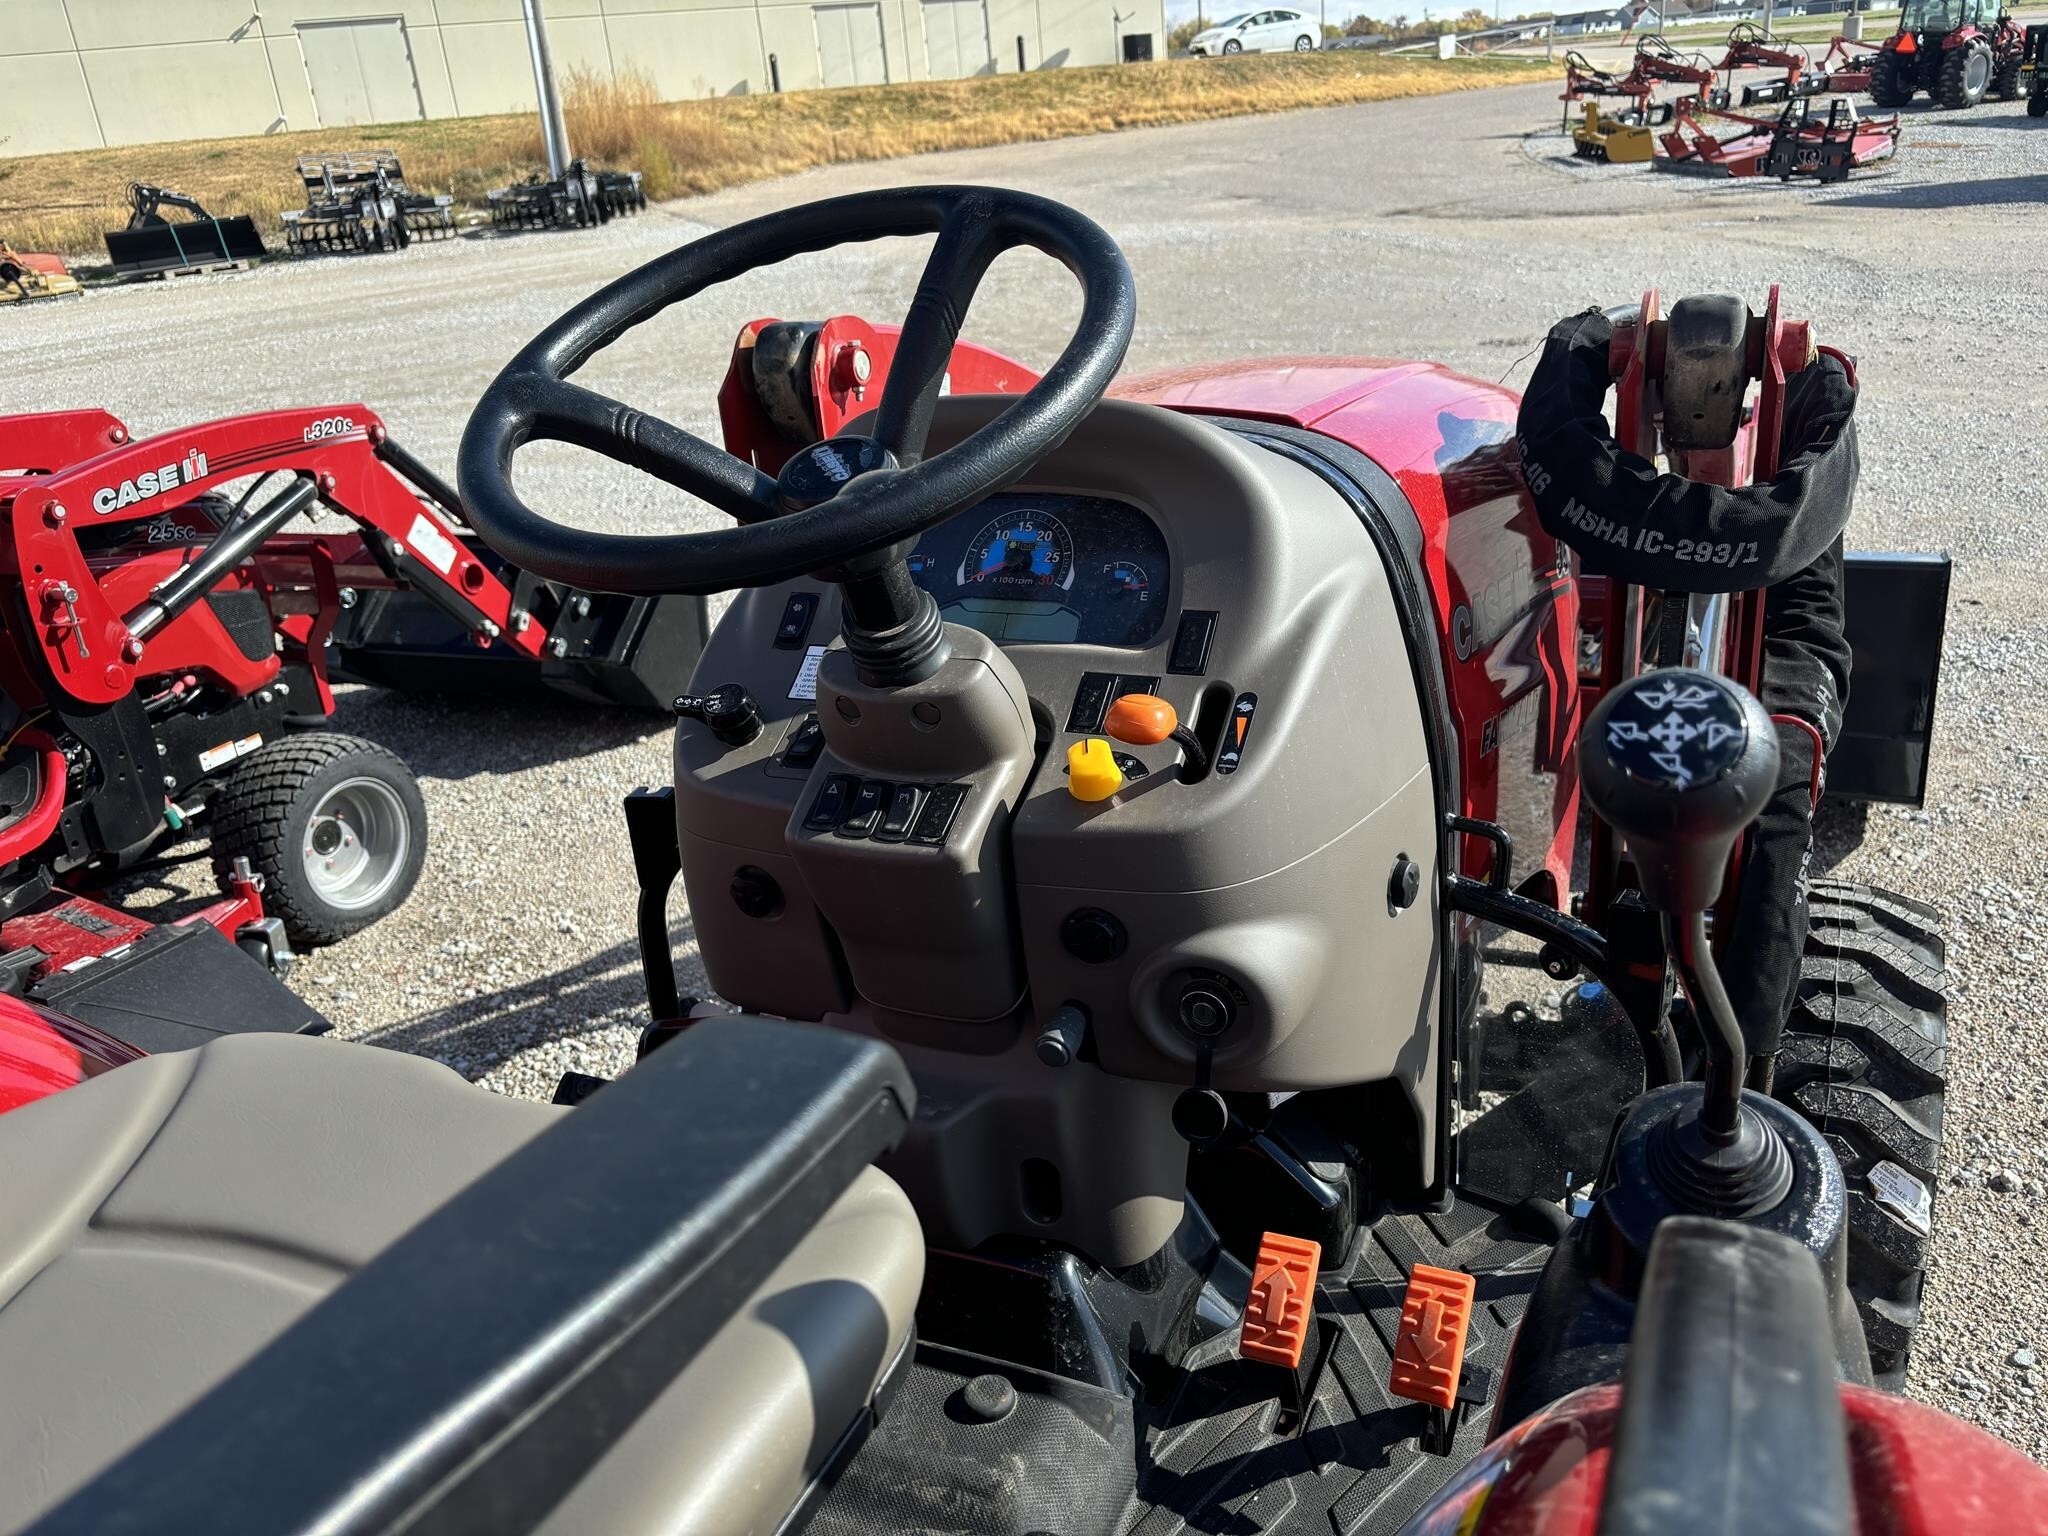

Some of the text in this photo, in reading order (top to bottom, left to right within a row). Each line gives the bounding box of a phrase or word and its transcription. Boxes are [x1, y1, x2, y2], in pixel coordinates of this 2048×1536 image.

[93, 464, 179, 514] CASE
[1019, 521, 1034, 532] 15
[1561, 496, 1760, 568] MSHA IC-293/1
[995, 530, 1010, 541] 10
[1036, 530, 1053, 541] 20
[980, 548, 989, 559] 5
[1044, 552, 1061, 563] 25
[926, 558, 936, 567] H
[1103, 564, 1112, 574] F
[1037, 575, 1056, 585] 30
[1140, 591, 1149, 601] E
